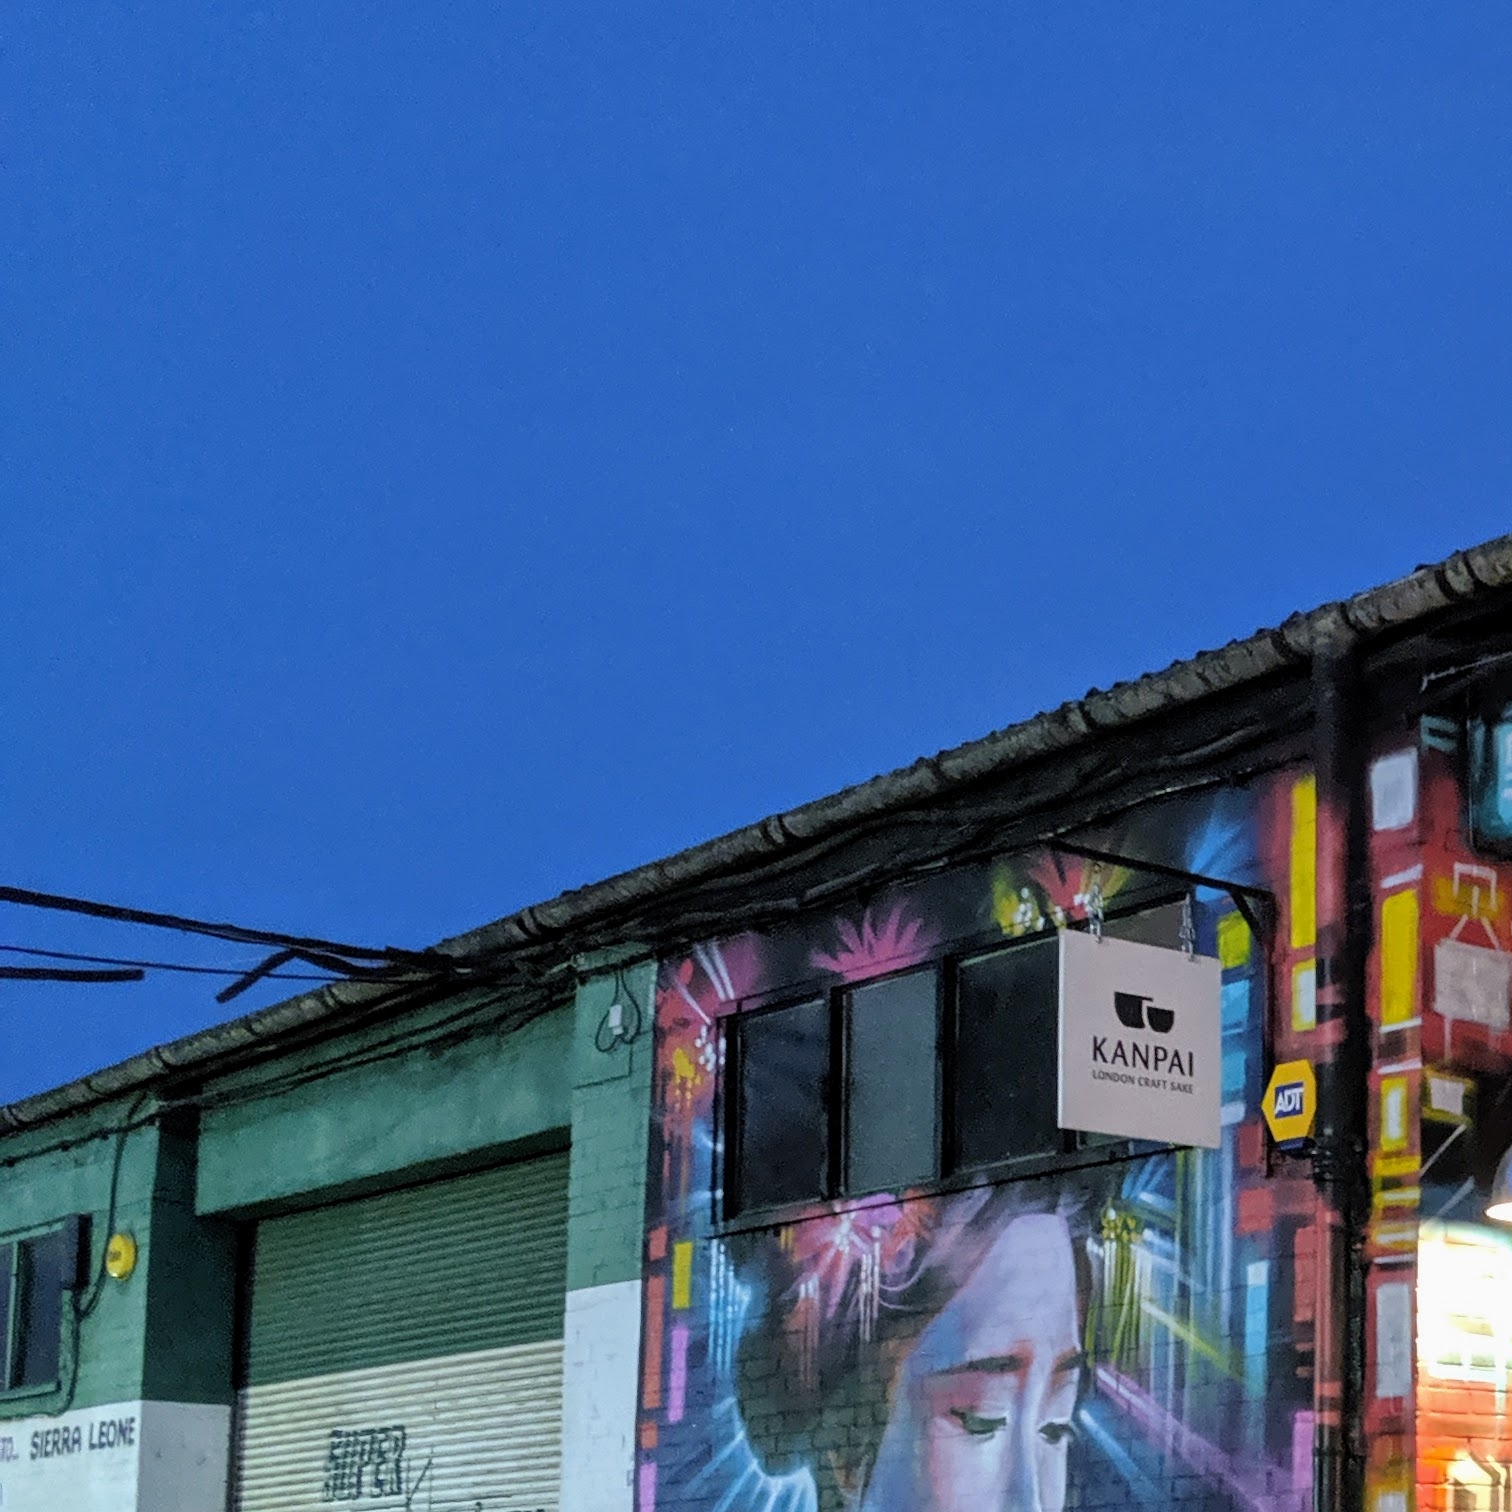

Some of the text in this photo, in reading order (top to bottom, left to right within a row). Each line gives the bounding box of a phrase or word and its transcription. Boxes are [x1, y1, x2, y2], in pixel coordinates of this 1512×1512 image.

[1093, 1035, 1193, 1077] KANPAI
[1093, 1069, 1193, 1094] LONDON CRAFT SAKE
[1275, 1087, 1304, 1114] ADT
[30, 1426, 81, 1460] SIERRA
[88, 1416, 136, 1450] LEONE
